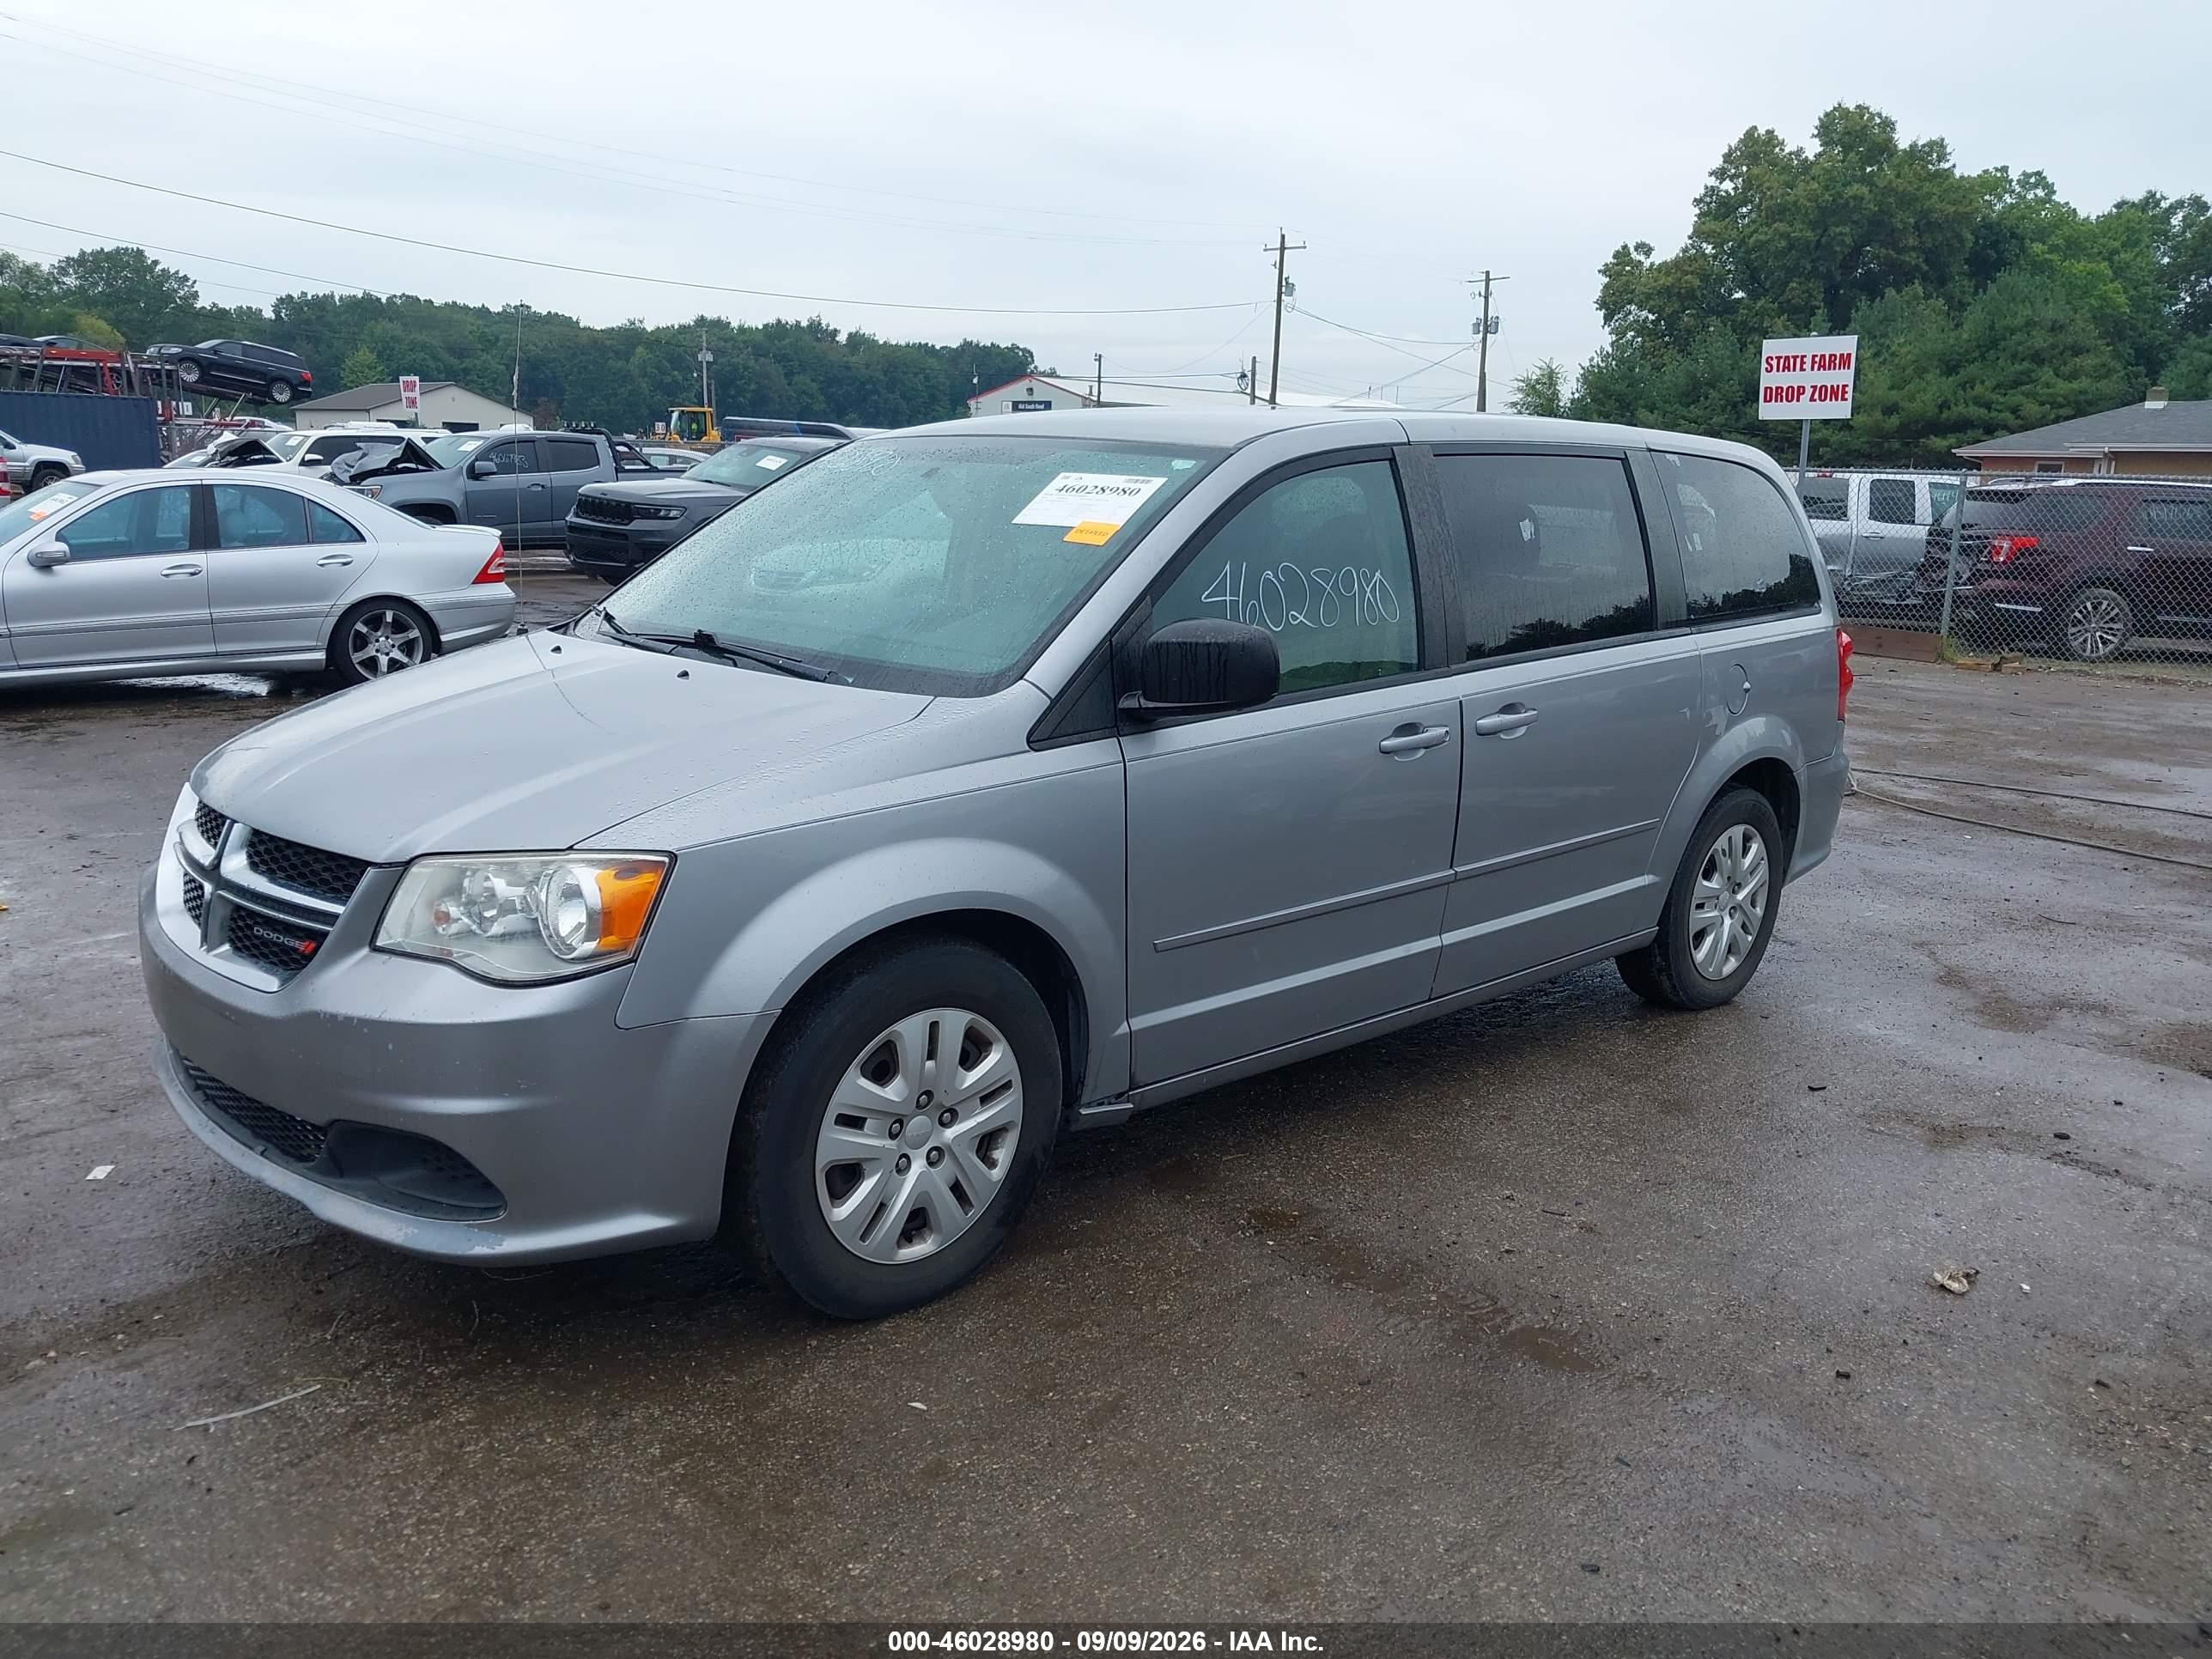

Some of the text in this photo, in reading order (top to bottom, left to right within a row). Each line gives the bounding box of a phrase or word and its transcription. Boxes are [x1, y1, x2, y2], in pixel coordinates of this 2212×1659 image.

[1765, 352, 1852, 374] STATE FARM
[402, 380, 417, 393] DROP
[1763, 384, 1850, 404] DROP ZONE
[404, 396, 418, 410] ZONE
[1055, 483, 1142, 498] 46028980
[1074, 527, 1109, 538] DETAILED
[1201, 560, 1401, 632] 46028980
[253, 927, 305, 951] DODGE
